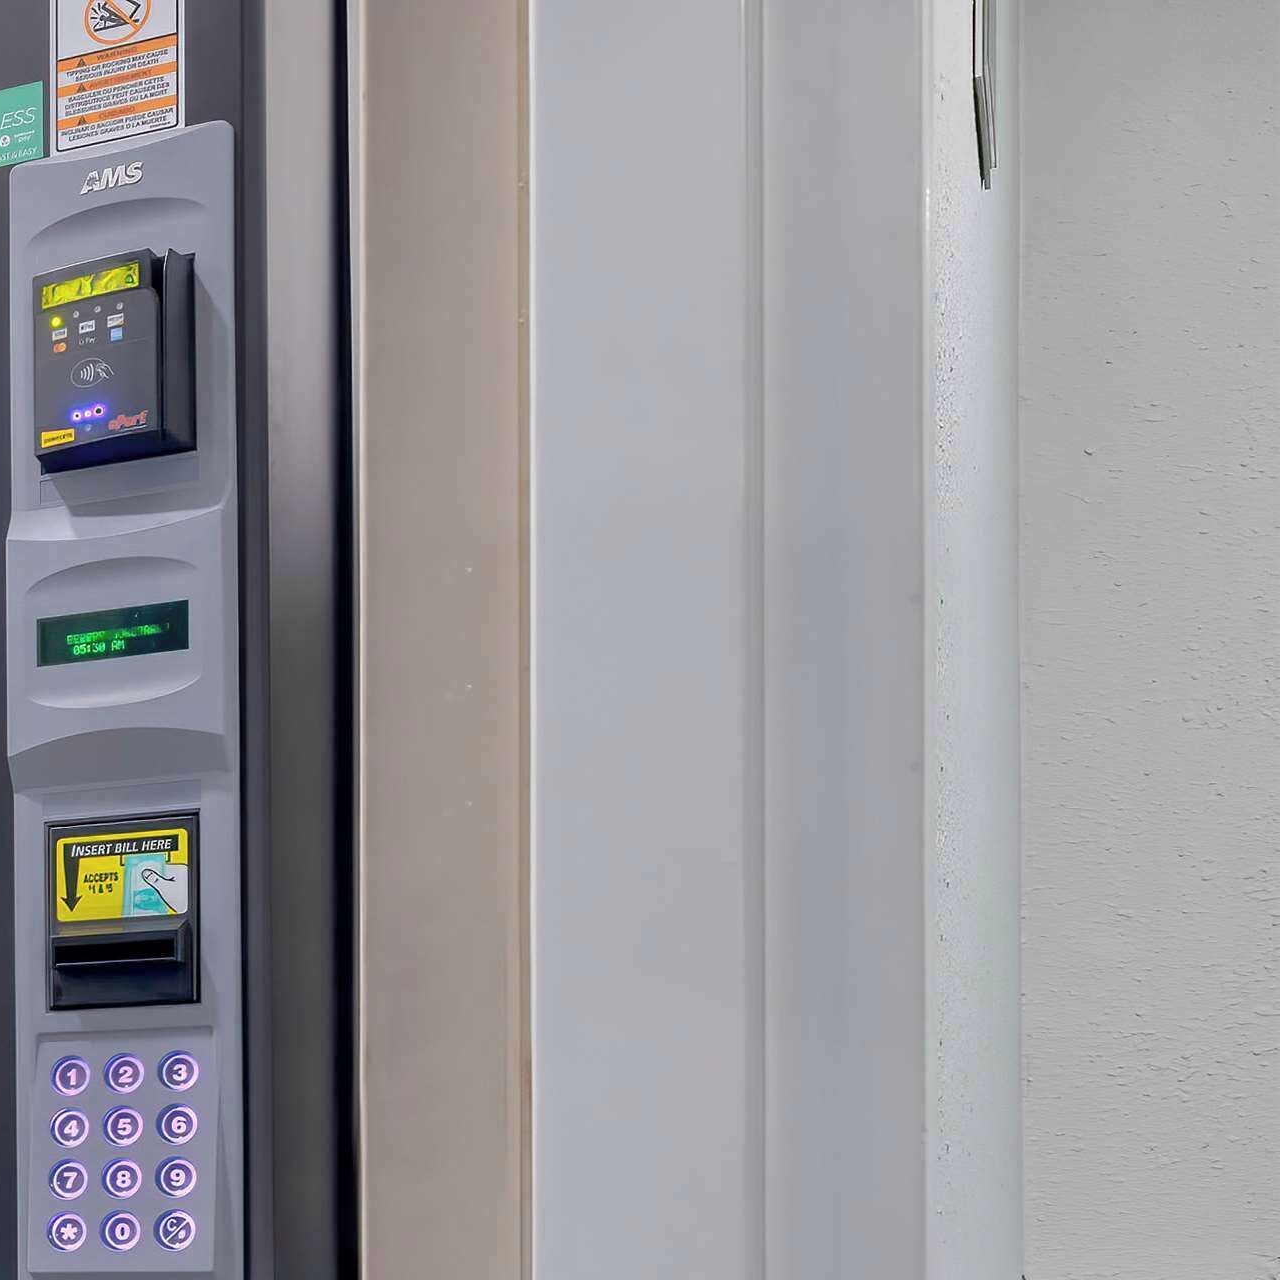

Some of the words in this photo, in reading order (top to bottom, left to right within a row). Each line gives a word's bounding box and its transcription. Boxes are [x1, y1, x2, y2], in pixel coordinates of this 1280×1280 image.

[137, 58, 159, 69] DEATH
[18, 147, 37, 158] EASY
[80, 162, 142, 195] AMS
[111, 640, 126, 651] AM
[71, 843, 112, 857] INSERT
[114, 841, 139, 853] BILL
[141, 838, 172, 852] HERE
[83, 871, 119, 883] ACCEPTS
[67, 1068, 77, 1085] 1
[118, 1066, 133, 1083] 2
[172, 1063, 188, 1081] 3
[63, 1119, 79, 1137] 4
[117, 1118, 132, 1135] 5
[171, 1116, 187, 1133] 6
[63, 1172, 78, 1189] 7
[116, 1170, 131, 1188] 8
[170, 1169, 186, 1187] 9
[115, 1223, 130, 1240] 0
